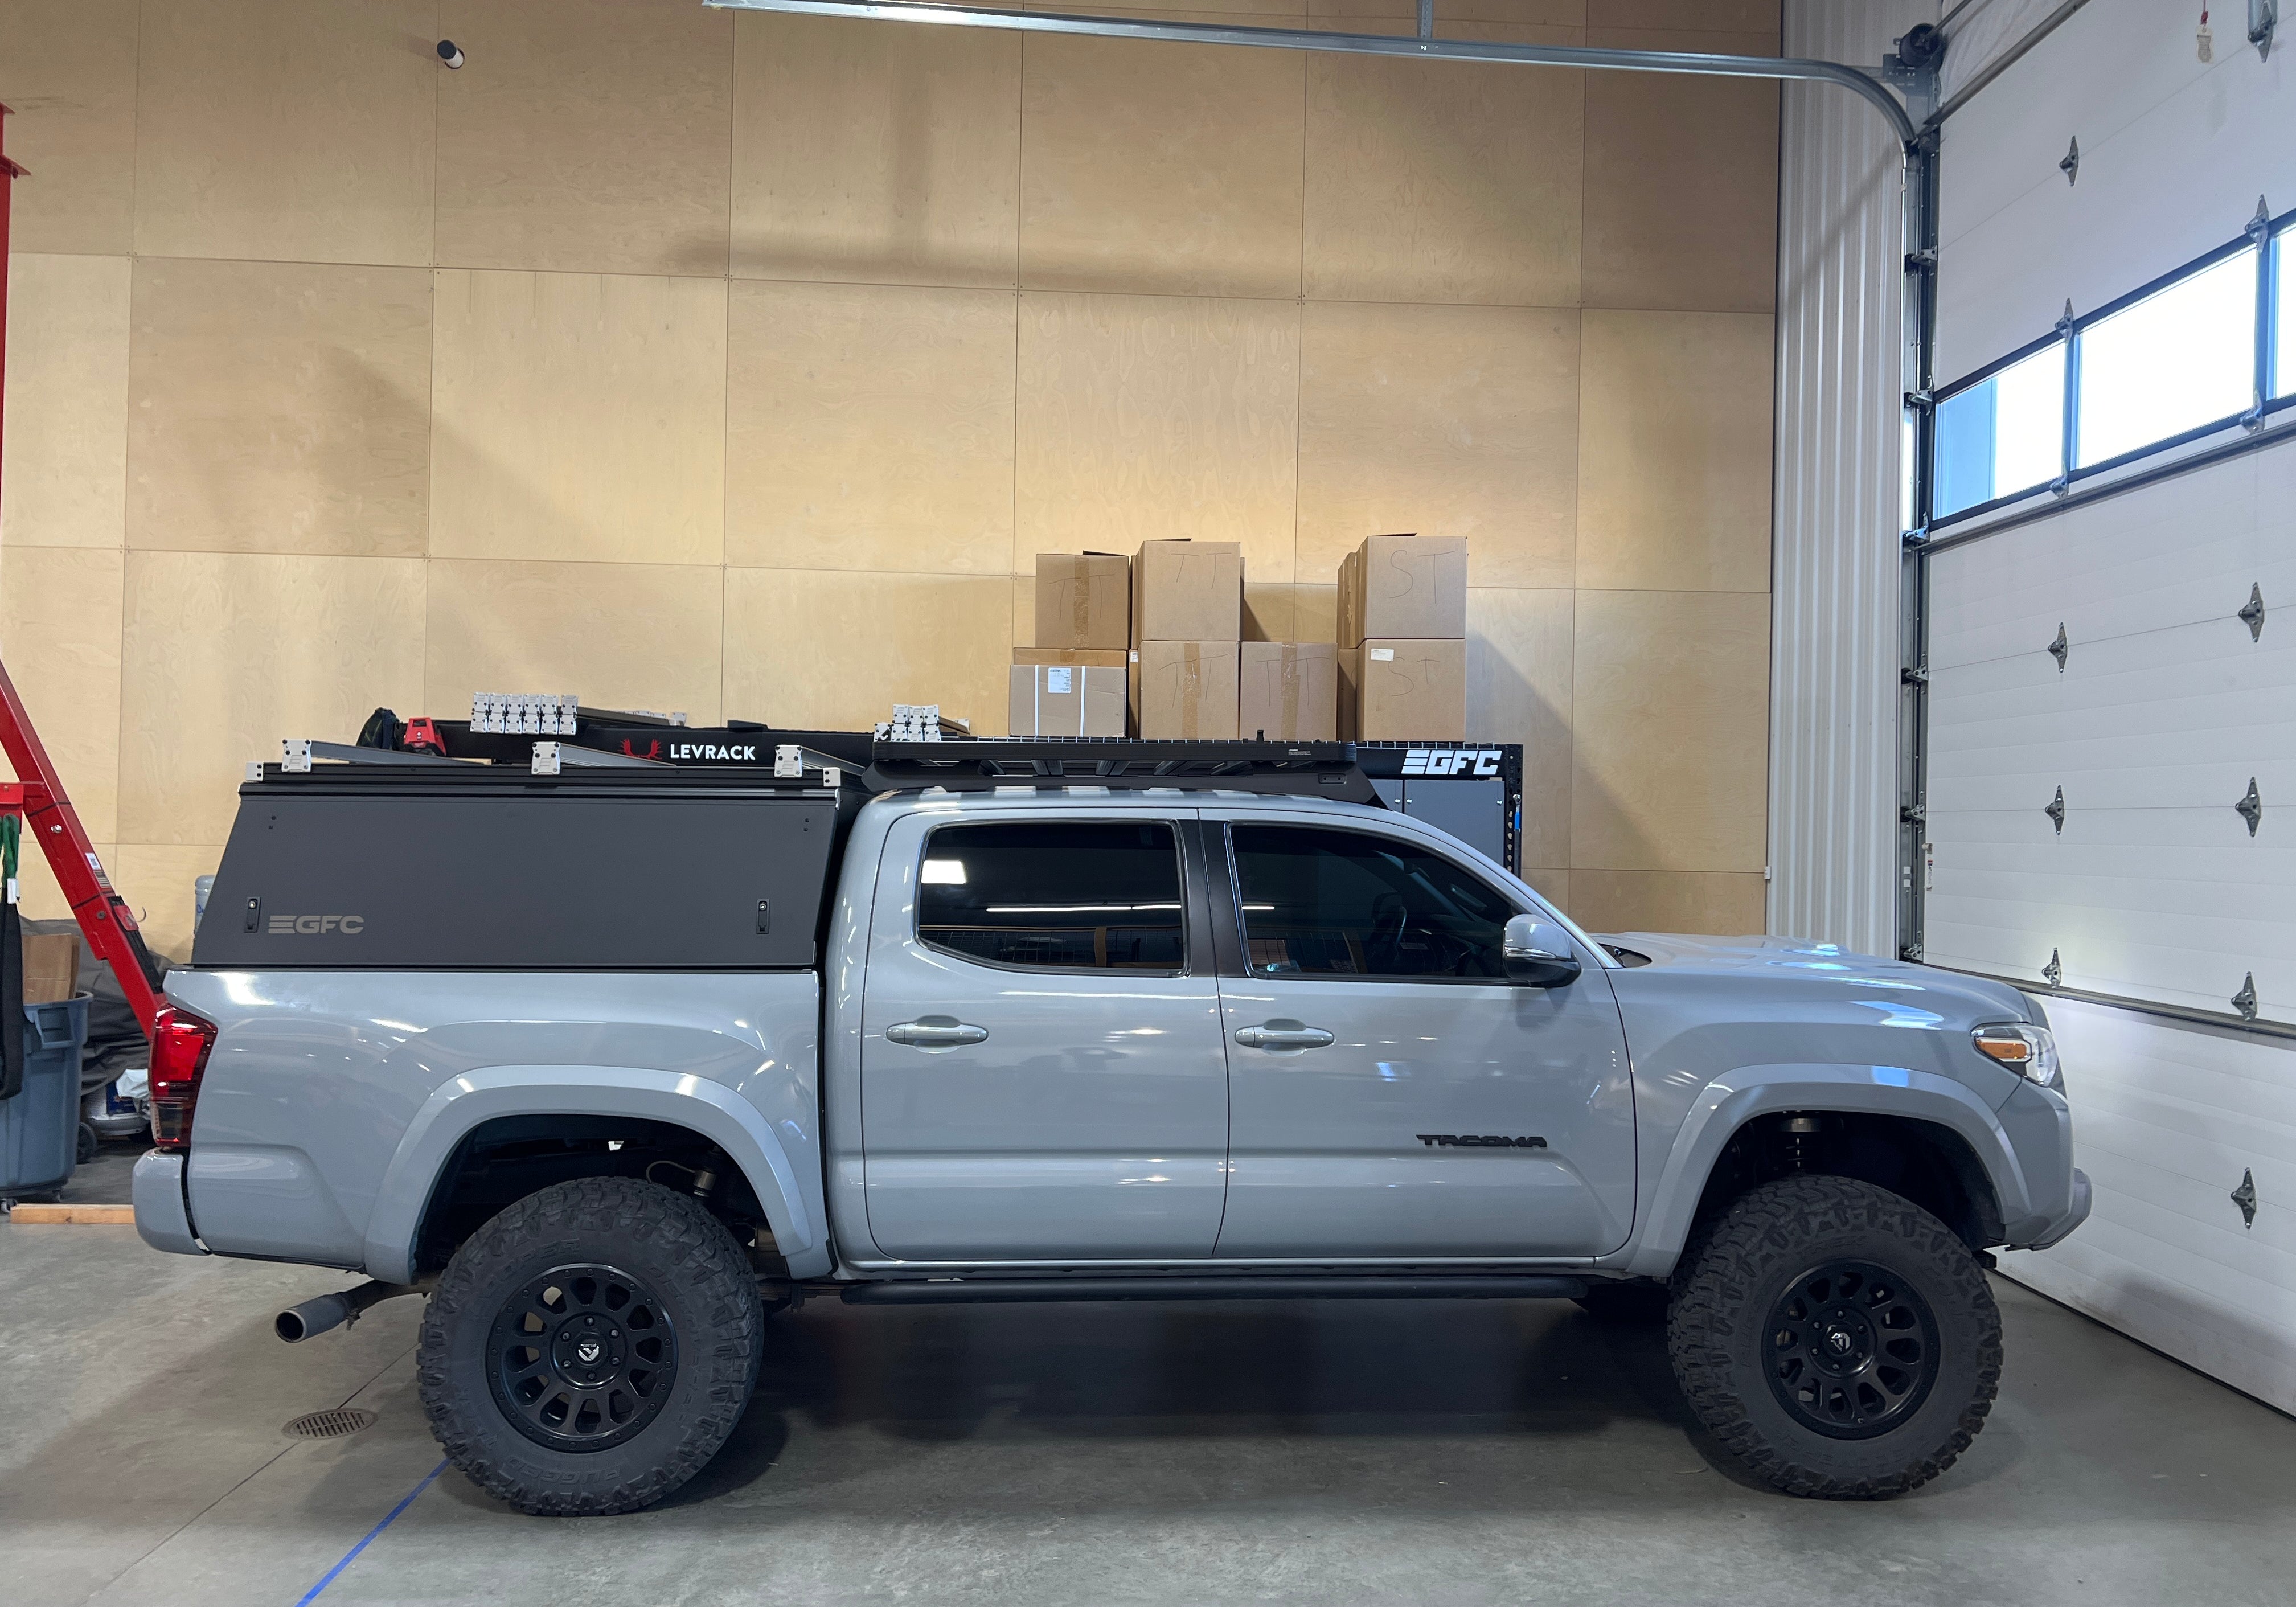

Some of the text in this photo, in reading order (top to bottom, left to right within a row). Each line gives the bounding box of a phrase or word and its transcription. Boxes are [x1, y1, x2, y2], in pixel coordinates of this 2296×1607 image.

[1389, 550, 1455, 604] ST
[1388, 657, 1440, 697] ST
[670, 744, 756, 760] LEVRACK
[1416, 1134, 1548, 1147] TACOMA
